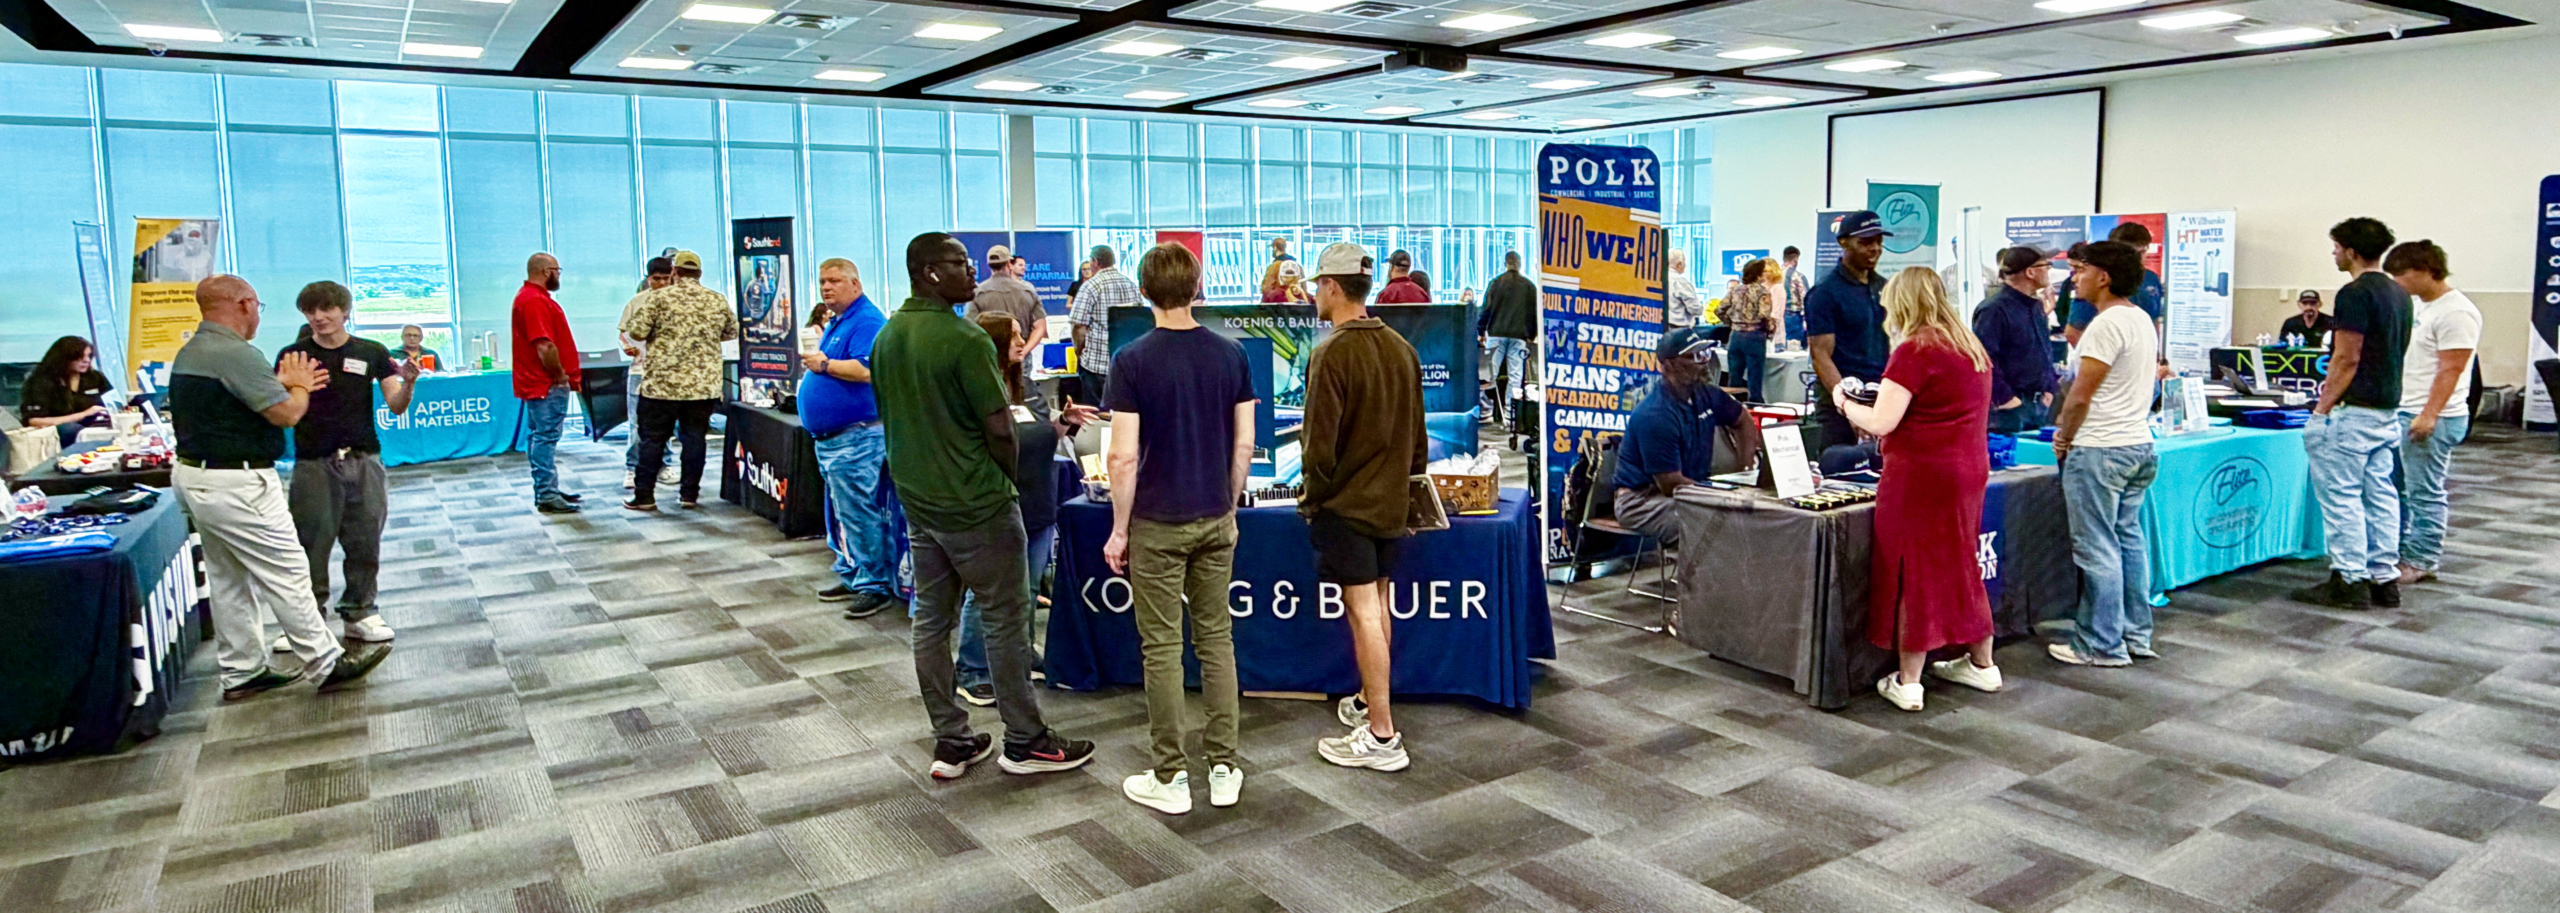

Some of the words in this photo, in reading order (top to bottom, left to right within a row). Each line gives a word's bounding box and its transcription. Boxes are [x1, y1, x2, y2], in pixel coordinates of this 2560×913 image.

[1549, 156, 1655, 186] POLK
[1550, 189, 1586, 197] COMMERCIAL
[1594, 190, 1626, 198] INDUSTRIAL
[1633, 191, 1655, 199] SERVICE
[2008, 220, 2035, 228] RIELLO
[2036, 219, 2064, 227] ARRAY
[752, 236, 782, 248] Southland
[2177, 229, 2199, 244] HT
[2200, 228, 2223, 237] WATER
[1541, 210, 1584, 270] WHO
[1585, 230, 1635, 265] WE
[1634, 226, 1663, 282] AR
[1032, 263, 1051, 271] ARE
[1574, 296, 1591, 315] ON
[1224, 317, 1275, 328] KOENIG
[1277, 318, 1286, 328] &
[1288, 317, 1333, 329] BAUER
[1545, 362, 1621, 392] JEANS
[415, 397, 490, 416] APPLIED
[1546, 388, 1620, 410] WEARING
[415, 411, 491, 428] MATERIALS
[1554, 409, 1632, 431] CAMARA
[1553, 428, 1572, 454] &
[1081, 577, 1254, 618] KOG
[1272, 580, 1300, 619] &
[1319, 581, 1488, 619] BUER
